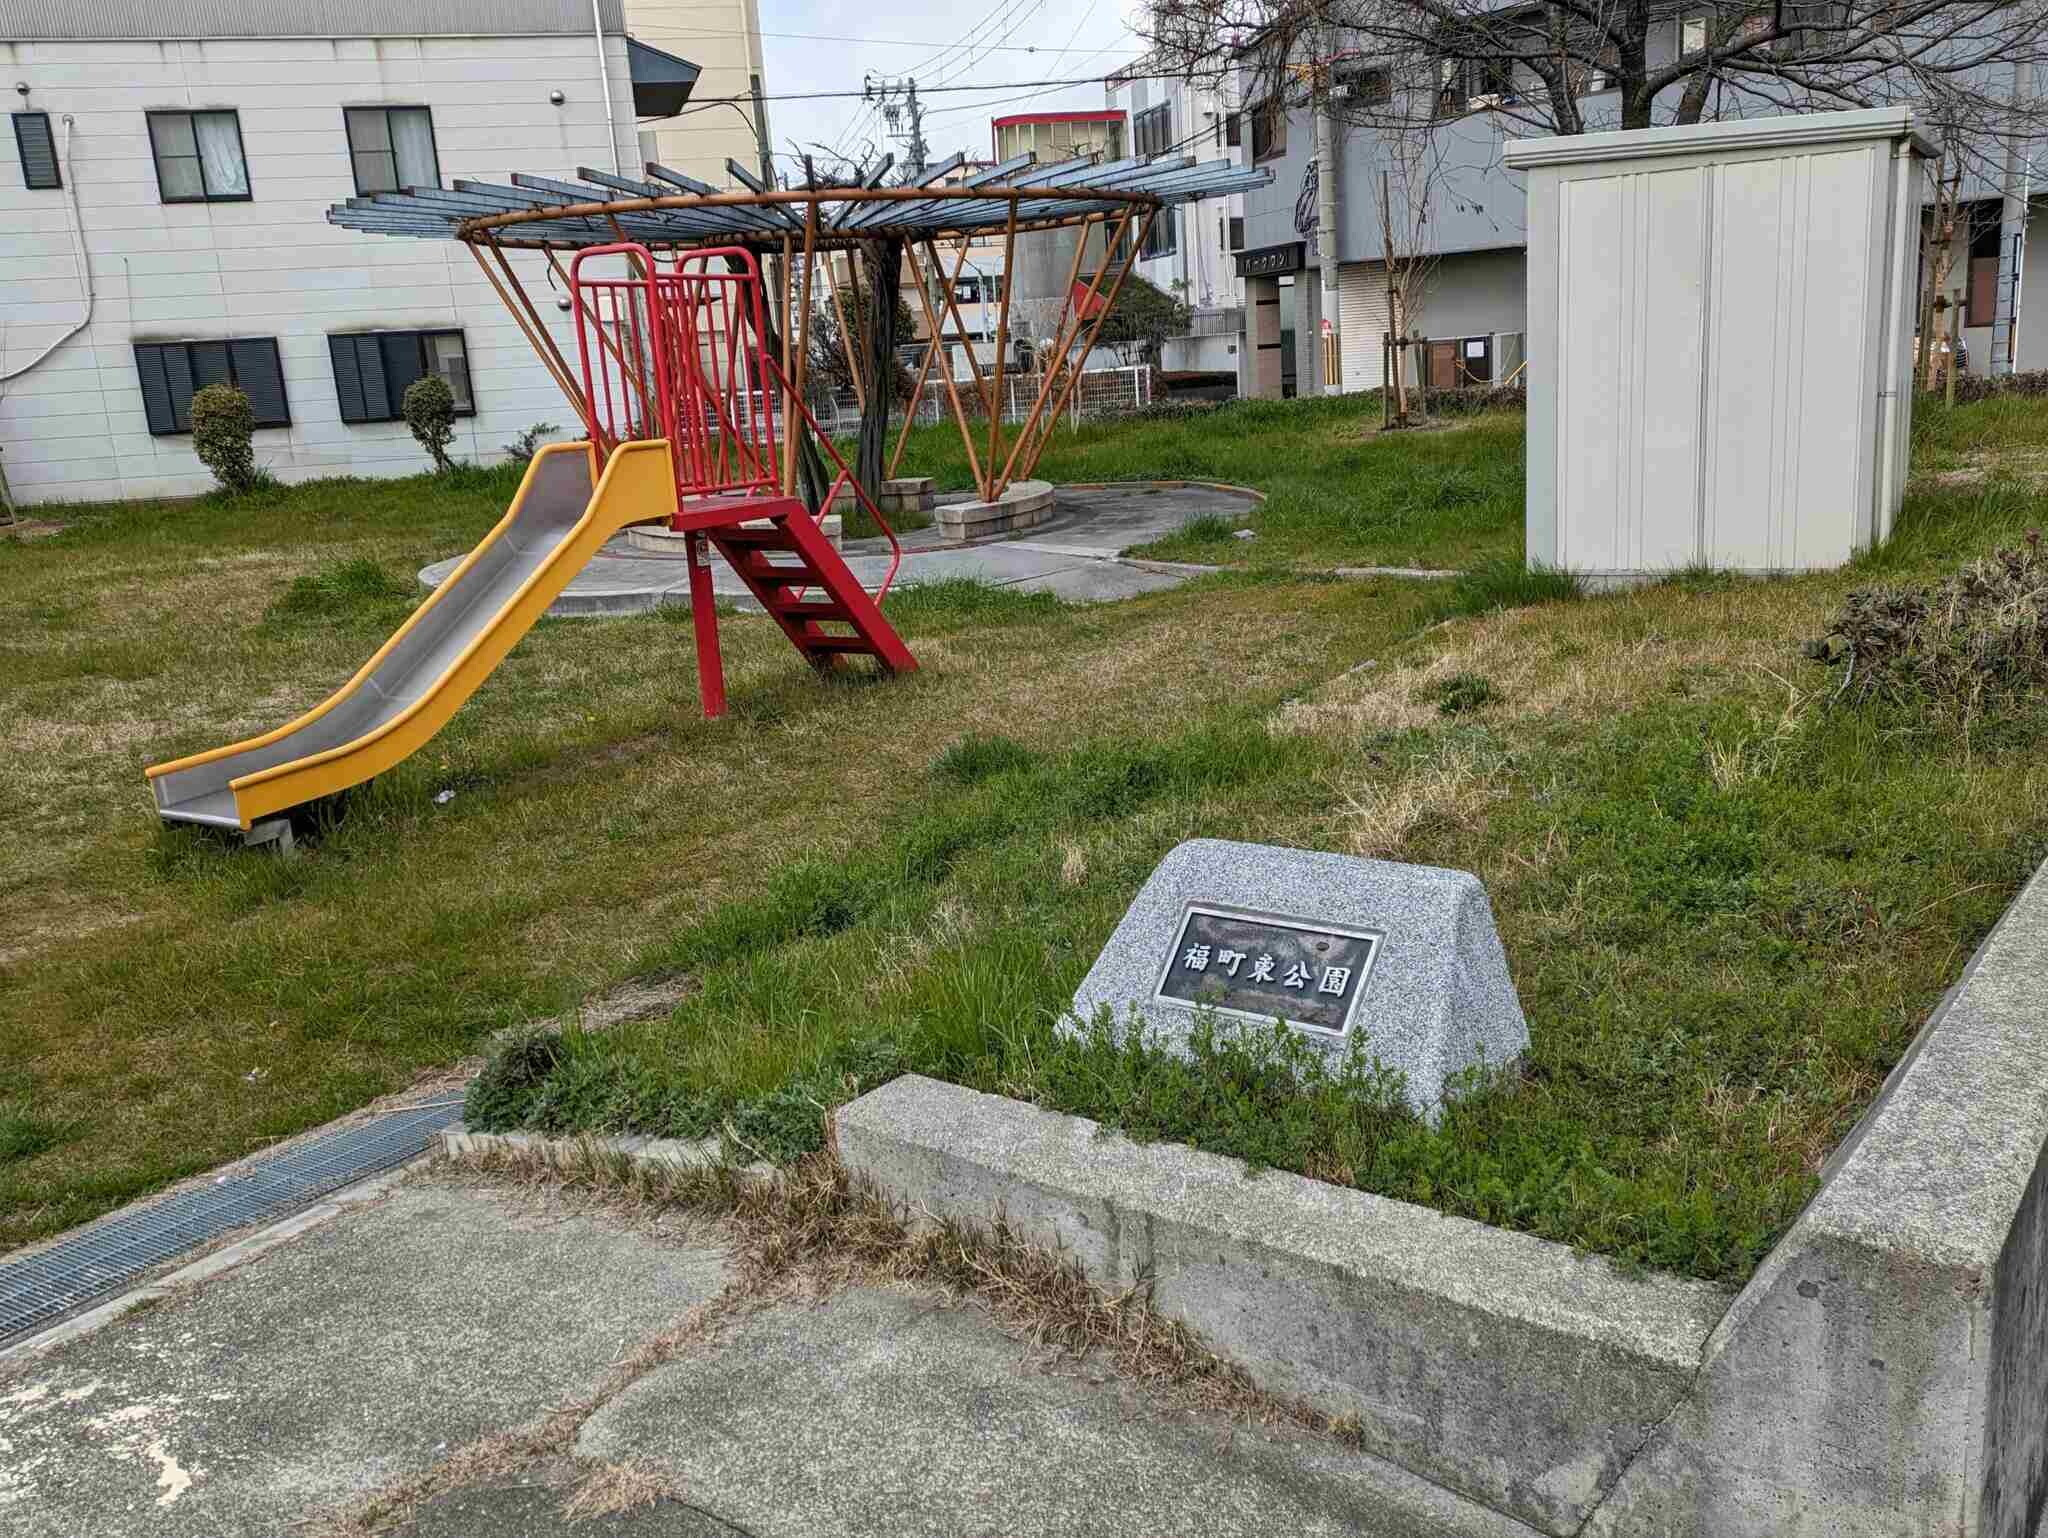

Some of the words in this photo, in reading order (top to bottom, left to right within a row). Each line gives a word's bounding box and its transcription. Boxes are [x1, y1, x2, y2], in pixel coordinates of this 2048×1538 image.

[1183, 942, 1351, 997] 福町東公園
